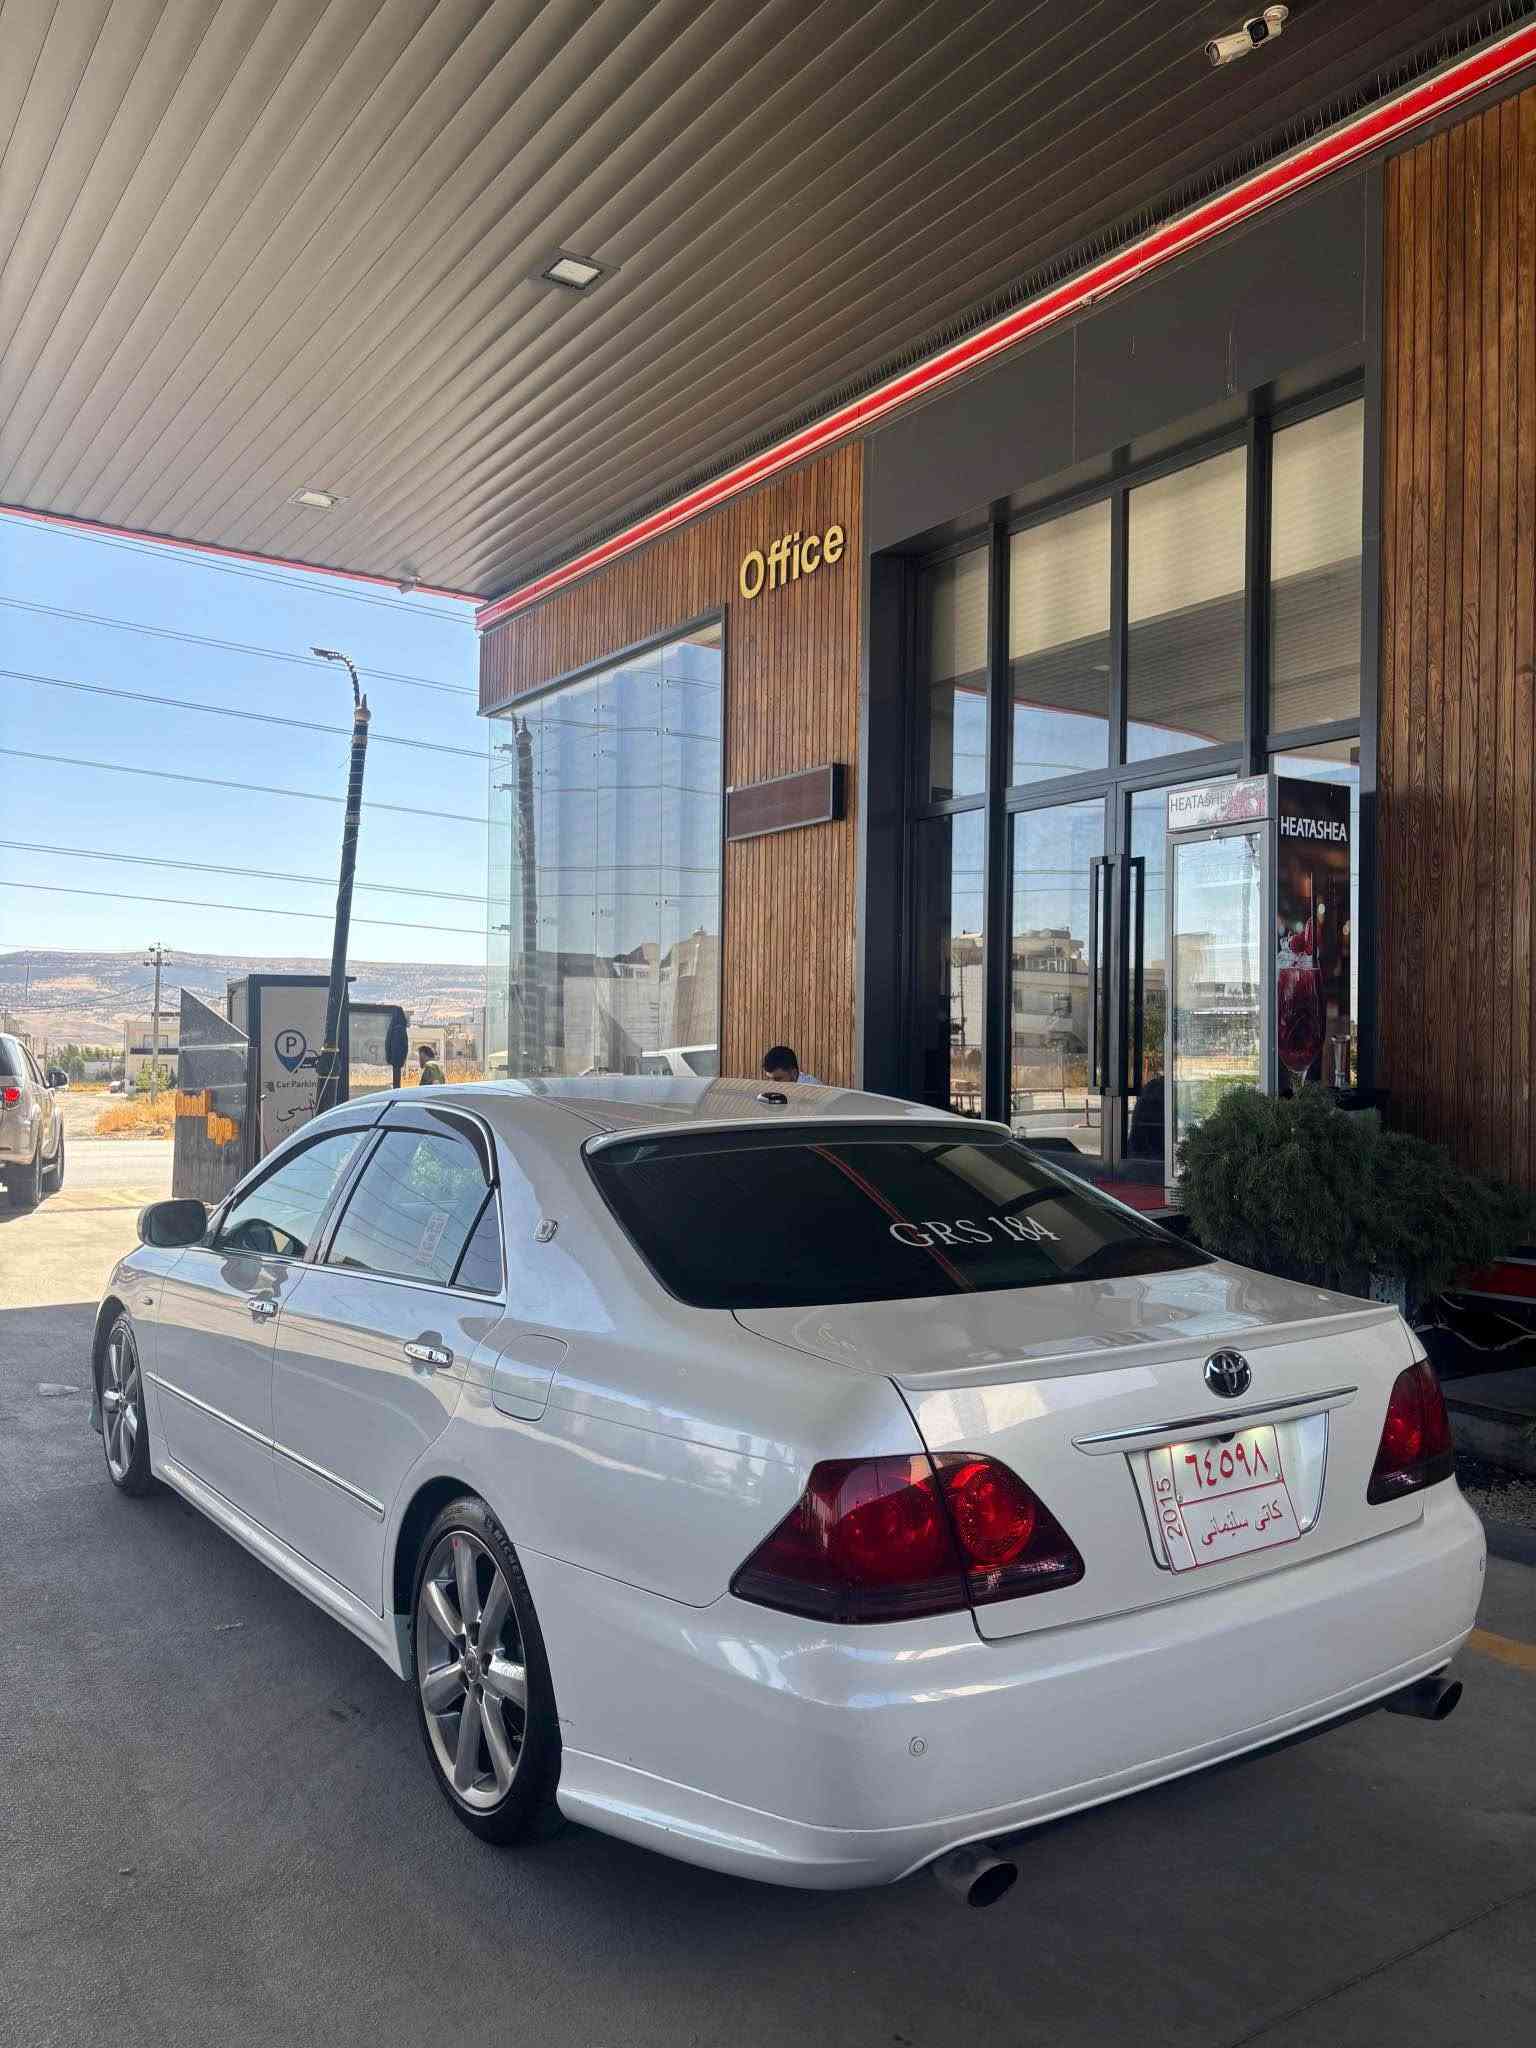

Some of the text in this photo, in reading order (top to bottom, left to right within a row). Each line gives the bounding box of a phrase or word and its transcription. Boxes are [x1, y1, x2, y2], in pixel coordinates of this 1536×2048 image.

[739, 525, 845, 599] Office
[1280, 815, 1348, 842] HEATASHEA
[276, 1080, 318, 1089] Car Parkin
[889, 1216, 1062, 1247] GRS 184
[1184, 1440, 1269, 1488] ٦٤٥٩٨
[1156, 1477, 1184, 1541] 2015
